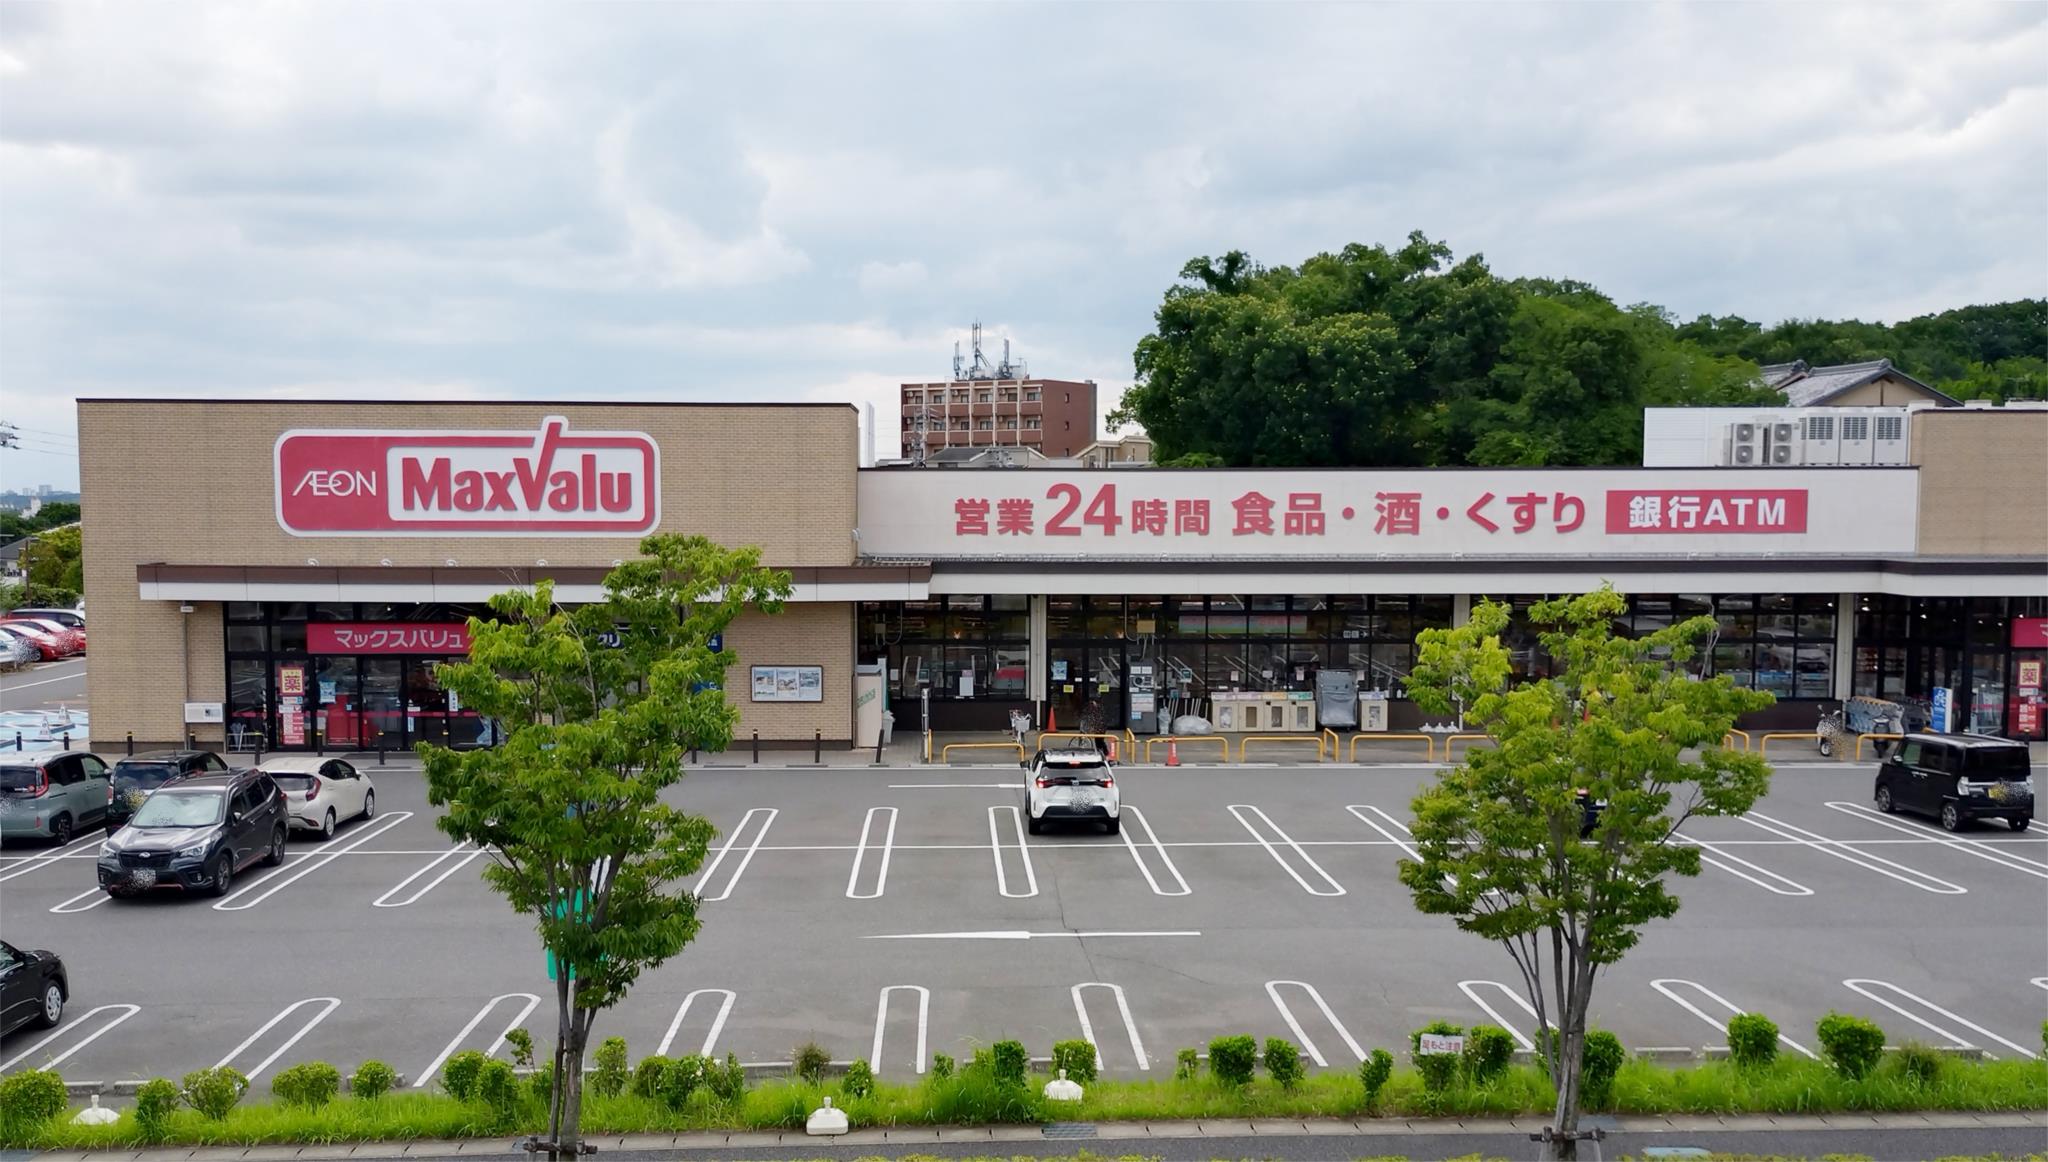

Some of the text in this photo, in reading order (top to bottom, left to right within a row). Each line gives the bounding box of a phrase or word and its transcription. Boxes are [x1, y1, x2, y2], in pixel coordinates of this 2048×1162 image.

[402, 422, 632, 513] MaxValu
[1629, 496, 1786, 529] 銀行ATM
[334, 629, 463, 648] マックスバリュ
